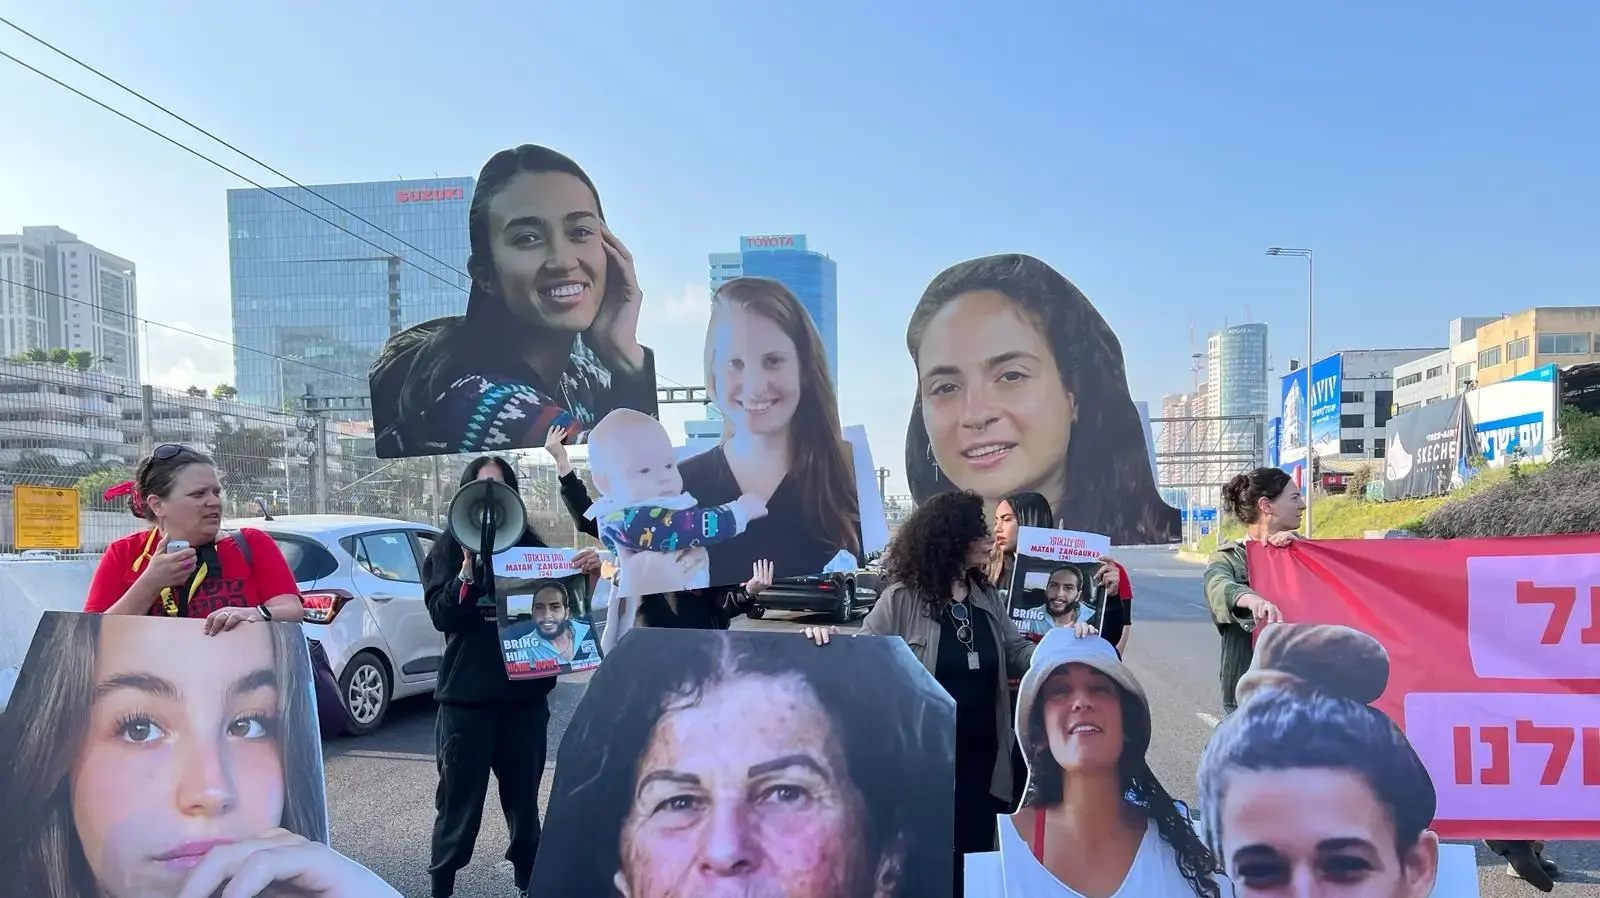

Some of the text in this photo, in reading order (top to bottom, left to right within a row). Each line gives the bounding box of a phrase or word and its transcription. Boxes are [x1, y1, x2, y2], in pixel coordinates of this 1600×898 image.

[397, 188, 463, 203] SUZUKI
[747, 236, 794, 248] TOYOTA
[1475, 421, 1543, 454] עם ישרא
[1416, 440, 1457, 464] SKECHE
[1031, 545, 1054, 553] MATAN
[505, 562, 575, 572] MATAN ZANGAUK
[1013, 607, 1044, 620] BRING
[503, 637, 539, 650] BRING
[505, 650, 529, 662] HIM
